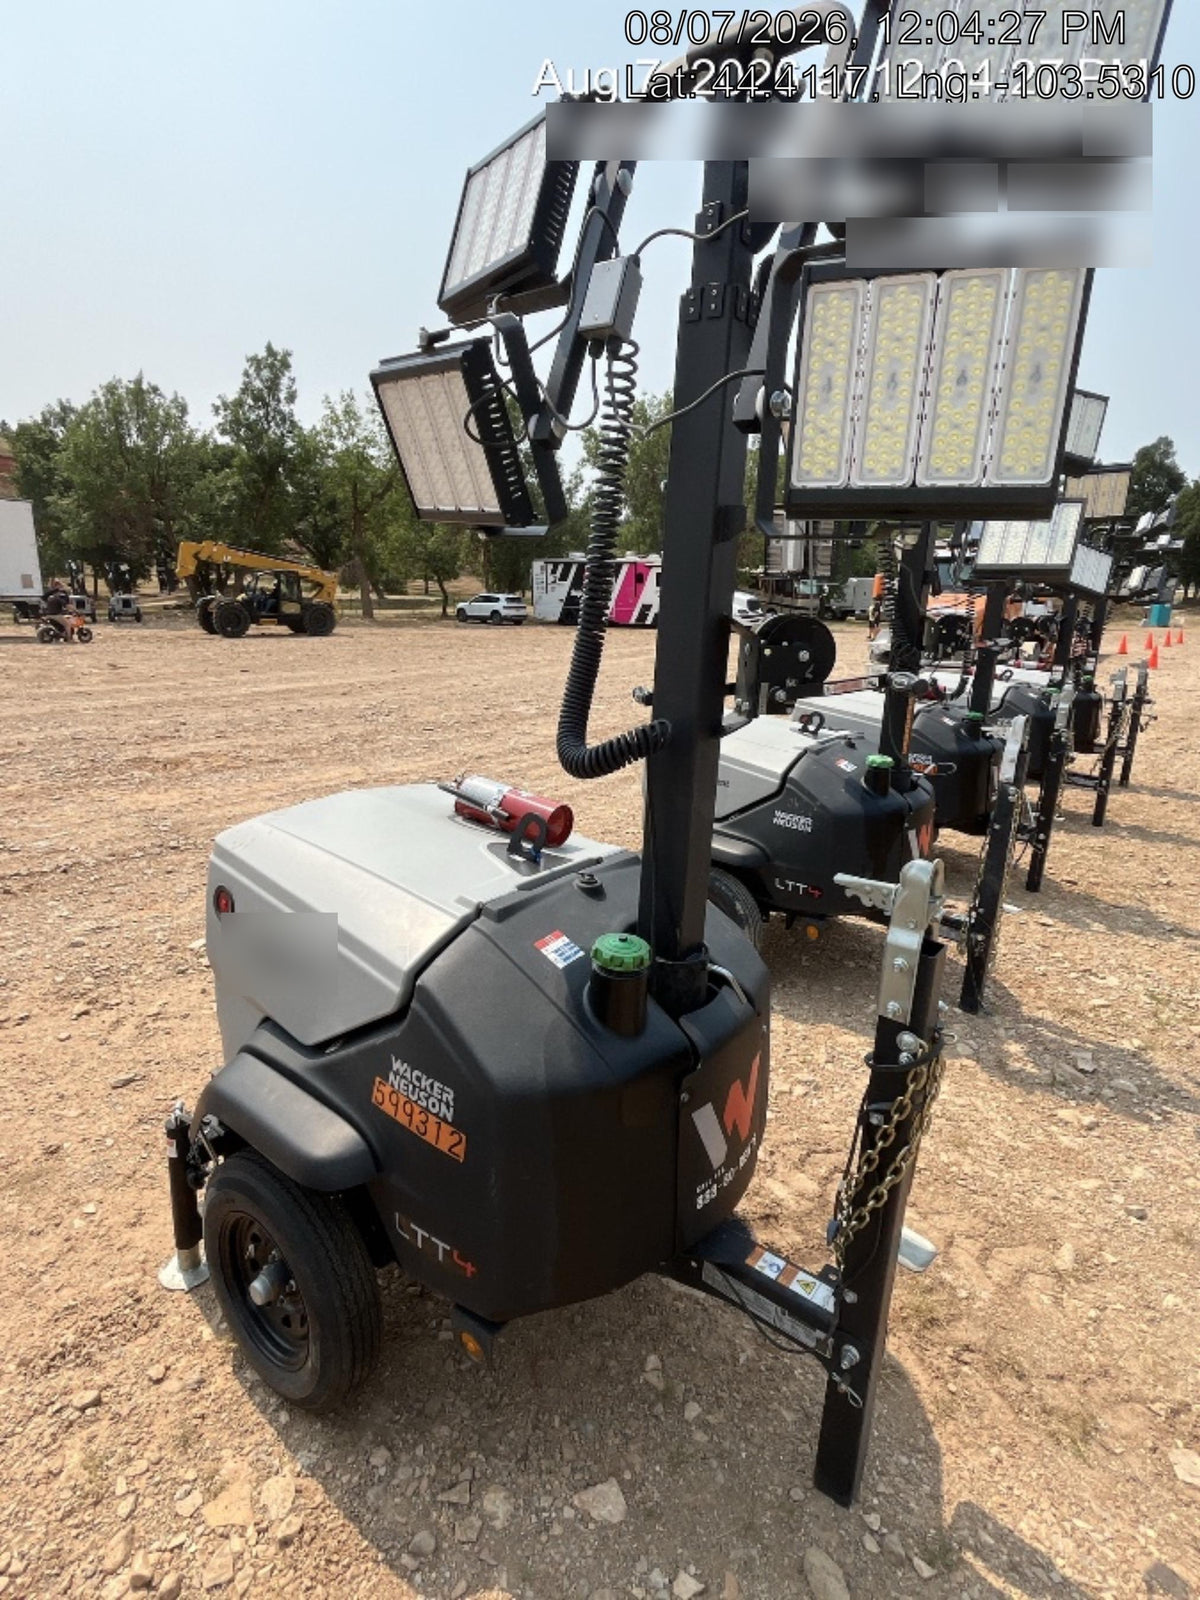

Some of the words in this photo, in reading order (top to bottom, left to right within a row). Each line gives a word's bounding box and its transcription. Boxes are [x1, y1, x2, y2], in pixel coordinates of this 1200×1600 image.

[774, 877, 823, 898] LTT4
[387, 1070, 455, 1123] NEUSON
[390, 1053, 456, 1106] WACKER
[373, 1079, 465, 1159] 599312
[395, 1211, 477, 1278] LTT4
